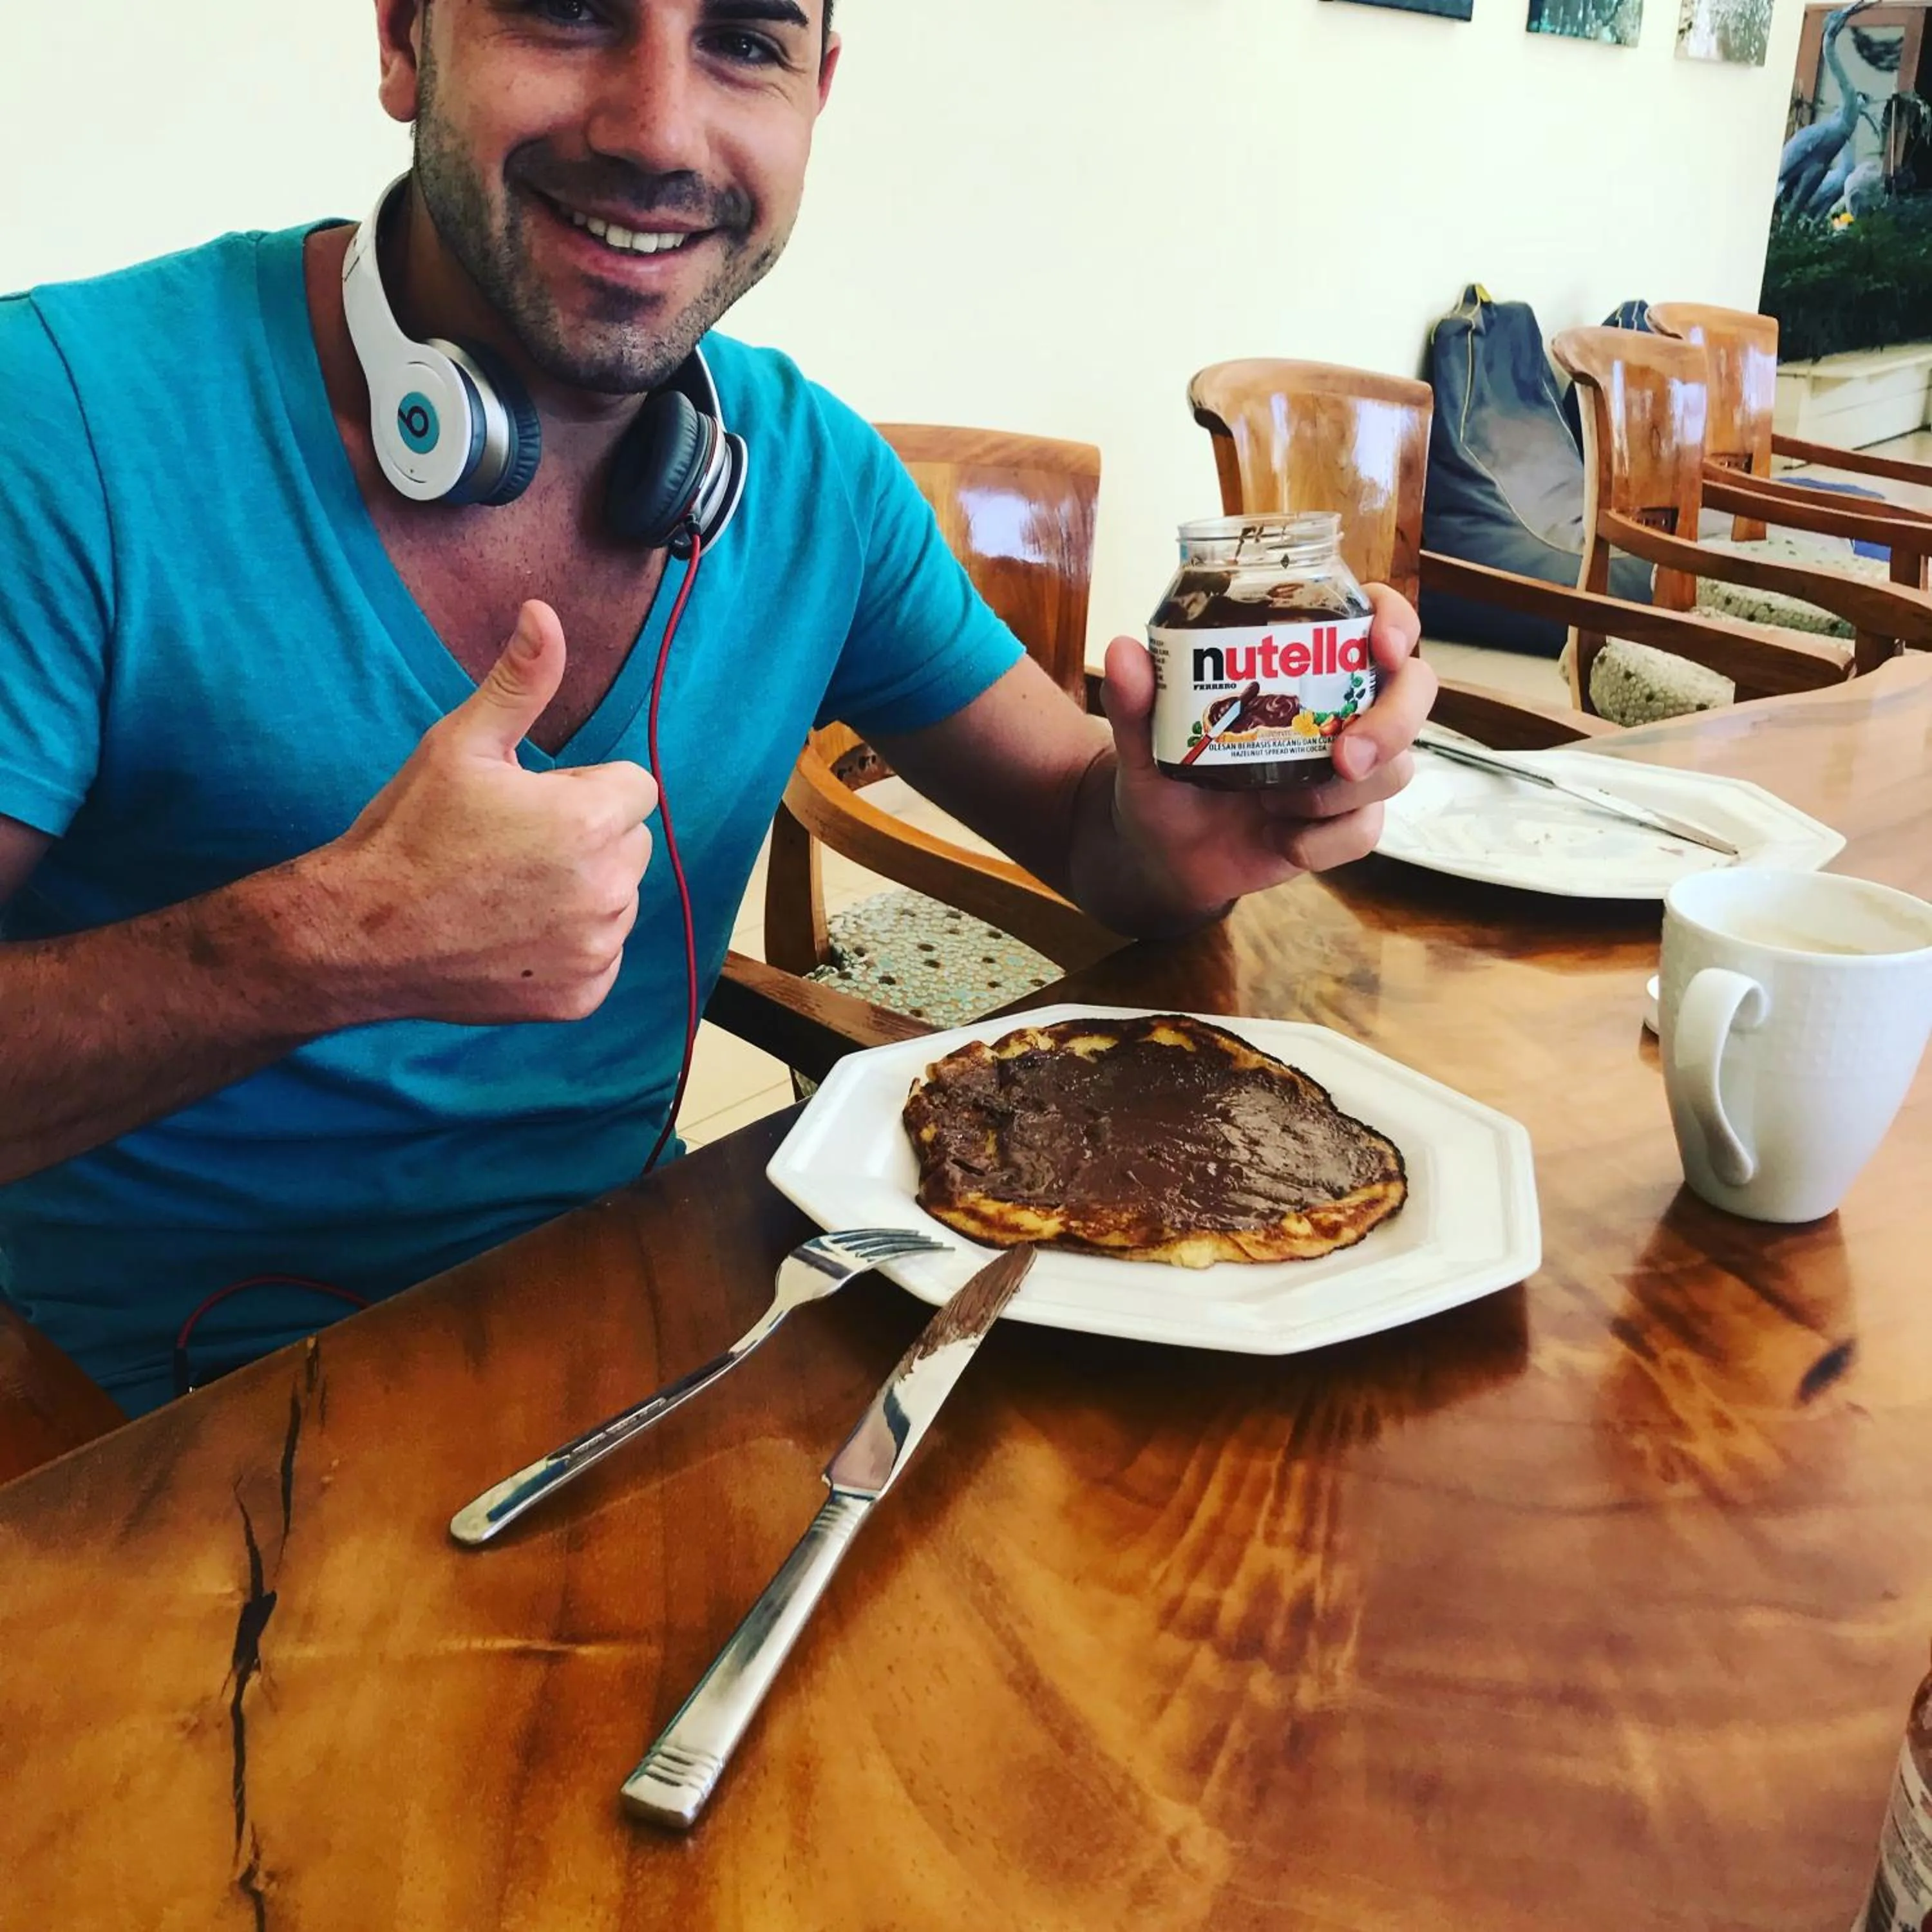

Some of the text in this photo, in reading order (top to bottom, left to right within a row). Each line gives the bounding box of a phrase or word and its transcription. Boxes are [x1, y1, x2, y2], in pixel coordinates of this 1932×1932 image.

[1193, 627, 1367, 682] nutella
[1209, 743, 1236, 752] OLESAN
[1302, 738, 1317, 746] DAN
[1231, 750, 1264, 758] HAZELNUT
[1264, 748, 1289, 756] SPREAD
[1305, 744, 1327, 753] COCOA
